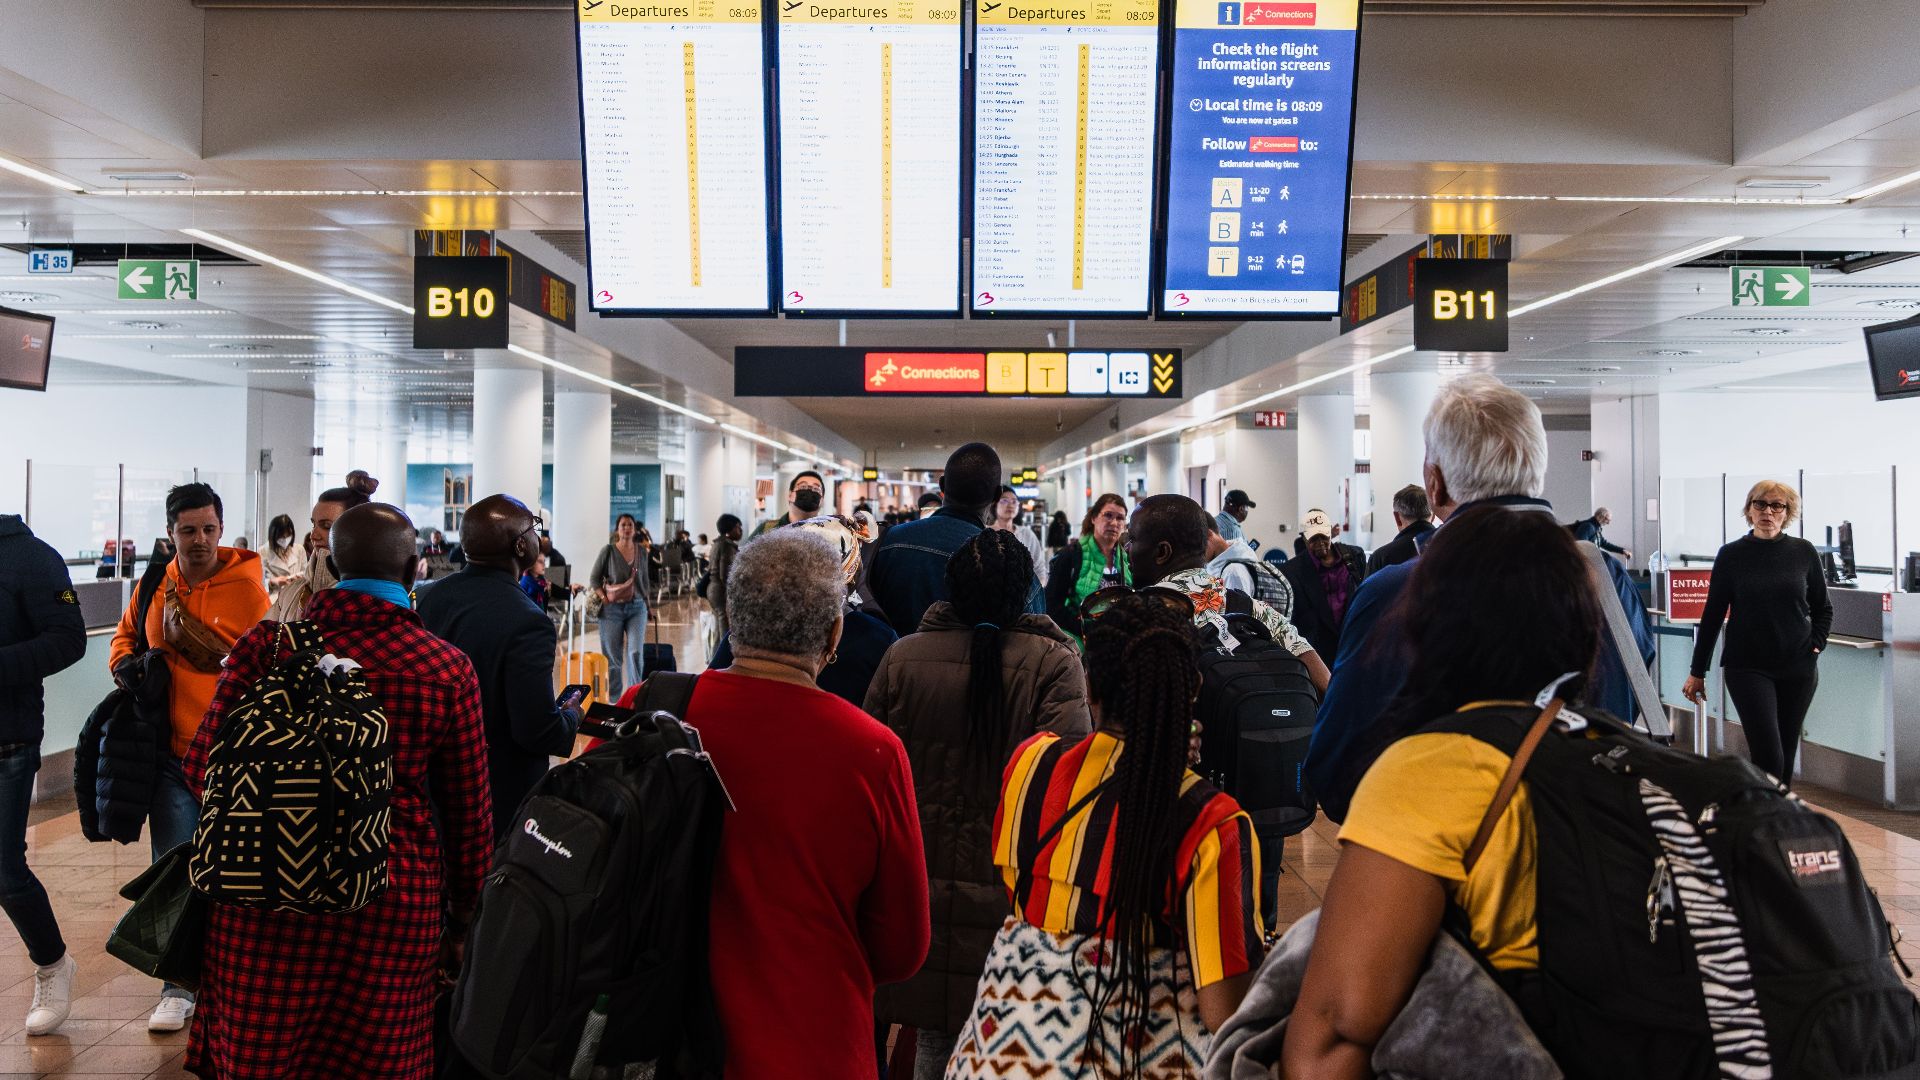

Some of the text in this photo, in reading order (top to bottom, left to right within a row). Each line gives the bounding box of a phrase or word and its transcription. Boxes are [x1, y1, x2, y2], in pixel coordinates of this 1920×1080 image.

[611, 5, 688, 18] Departures
[729, 9, 757, 17] 08:09
[810, 6, 888, 20] Departures
[929, 10, 956, 19] 08:09
[1008, 7, 1085, 21] Departures
[1127, 11, 1154, 21] 08:09
[1266, 10, 1313, 18] Connections
[1213, 43, 1318, 58] Check the flight
[1198, 58, 1330, 71] information screens
[1234, 74, 1294, 88] regularly
[1206, 99, 1322, 111] Local time is 08:09
[1223, 116, 1235, 124] You
[1273, 117, 1291, 126] gates
[1202, 138, 1246, 150] Follow
[1301, 139, 1317, 150] to:
[1219, 160, 1299, 169] Estimated walking time
[1220, 189, 1232, 204] A
[1218, 223, 1231, 238] B
[53, 256, 67, 268] 35
[1217, 257, 1229, 273] T
[428, 287, 495, 318] B10
[1250, 296, 1281, 304] Brussels
[1433, 290, 1495, 320] B11
[901, 365, 1056, 388] Connections B T
[524, 818, 572, 858] Champion
[1787, 848, 1841, 870] trans
